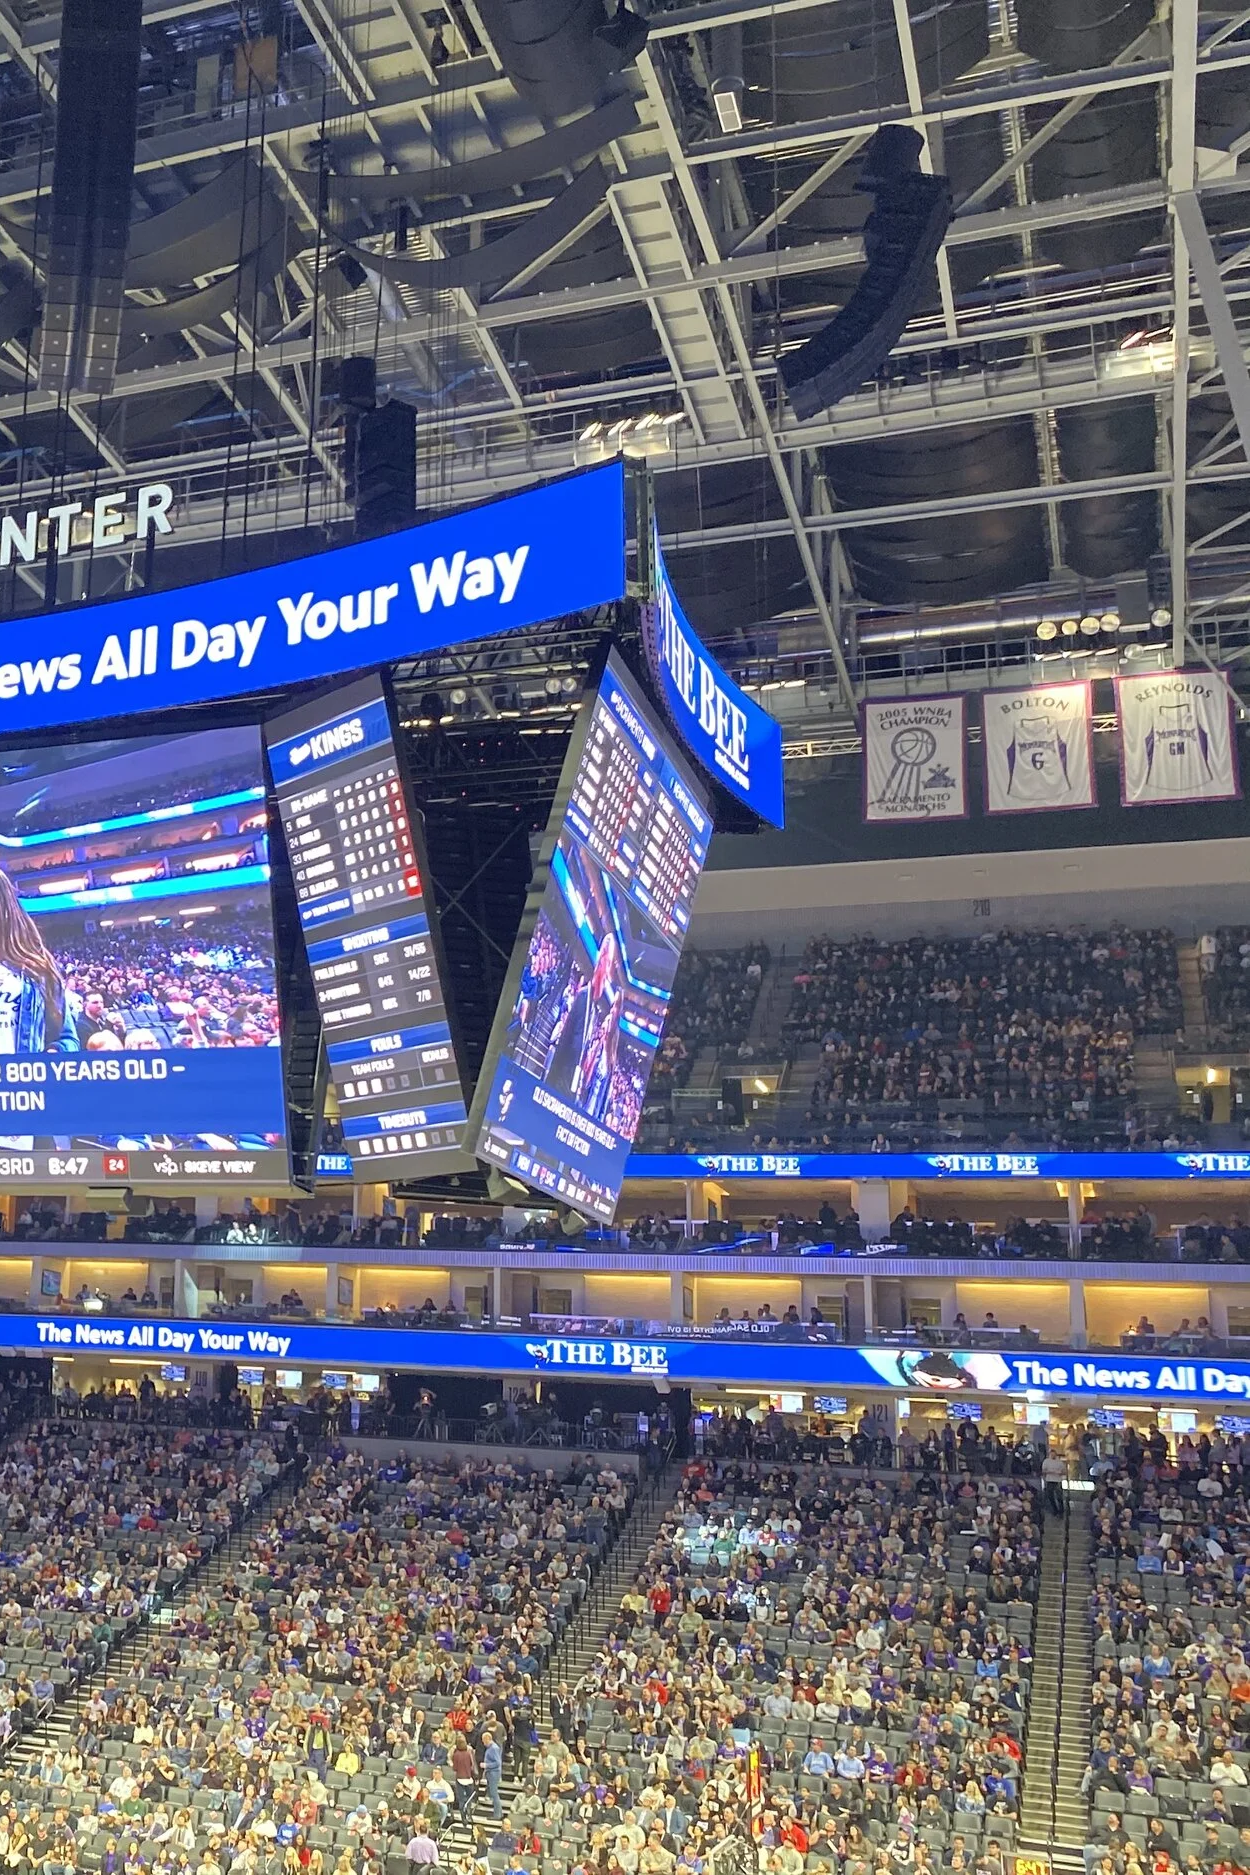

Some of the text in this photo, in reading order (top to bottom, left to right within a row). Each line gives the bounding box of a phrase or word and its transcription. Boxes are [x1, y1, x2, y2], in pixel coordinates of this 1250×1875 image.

[91, 624, 159, 685] All
[171, 615, 268, 671] Day
[277, 581, 399, 646] Your
[410, 545, 530, 614] Way
[662, 579, 749, 772] THE BEE
[1135, 682, 1214, 703] REYNOLDS
[878, 706, 952, 721] 2005 WNBA
[1000, 696, 1070, 715] BOLTON
[880, 716, 951, 731] CHAMPION
[309, 718, 365, 760] KINGS
[1169, 741, 1185, 756] GM
[885, 802, 947, 813] MONARCHS
[285, 821, 293, 832] 5
[288, 835, 299, 849] 24
[408, 965, 431, 982] 14/22
[370, 1034, 402, 1053] FOULS
[351, 1060, 371, 1076] TEAM
[421, 1047, 449, 1064] BONUS
[6, 1061, 47, 1084] 800
[50, 1059, 120, 1082] YEARS
[124, 1058, 167, 1080] OLD
[0, 1157, 34, 1175] 3RD
[108, 1159, 125, 1171] 24
[222, 1160, 257, 1174] VIEW
[720, 1155, 800, 1173] THE BEE
[950, 1154, 1038, 1172] THE BEE
[1201, 1153, 1250, 1171] THE
[37, 1322, 291, 1356] The News All Day Your Way
[547, 1339, 669, 1368] THE BEE
[1013, 1361, 1068, 1387] The
[1074, 1363, 1150, 1390] News
[1156, 1366, 1197, 1391] All
[872, 1404, 888, 1422] 121
